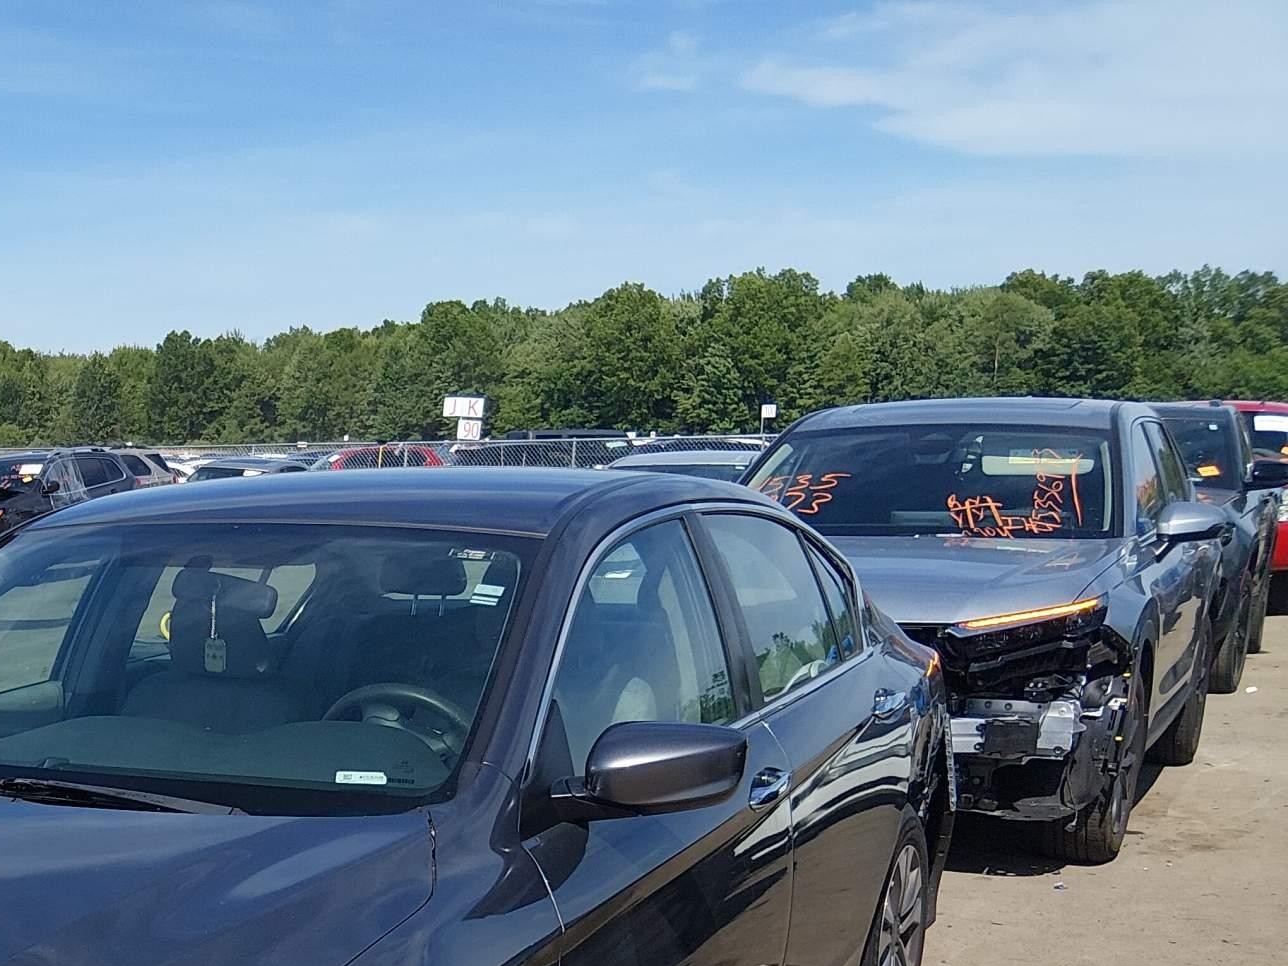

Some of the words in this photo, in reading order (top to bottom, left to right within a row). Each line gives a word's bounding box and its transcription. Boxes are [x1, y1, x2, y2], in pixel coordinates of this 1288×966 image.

[449, 399, 457, 415] J
[468, 399, 479, 416] K
[463, 422, 479, 438] 90
